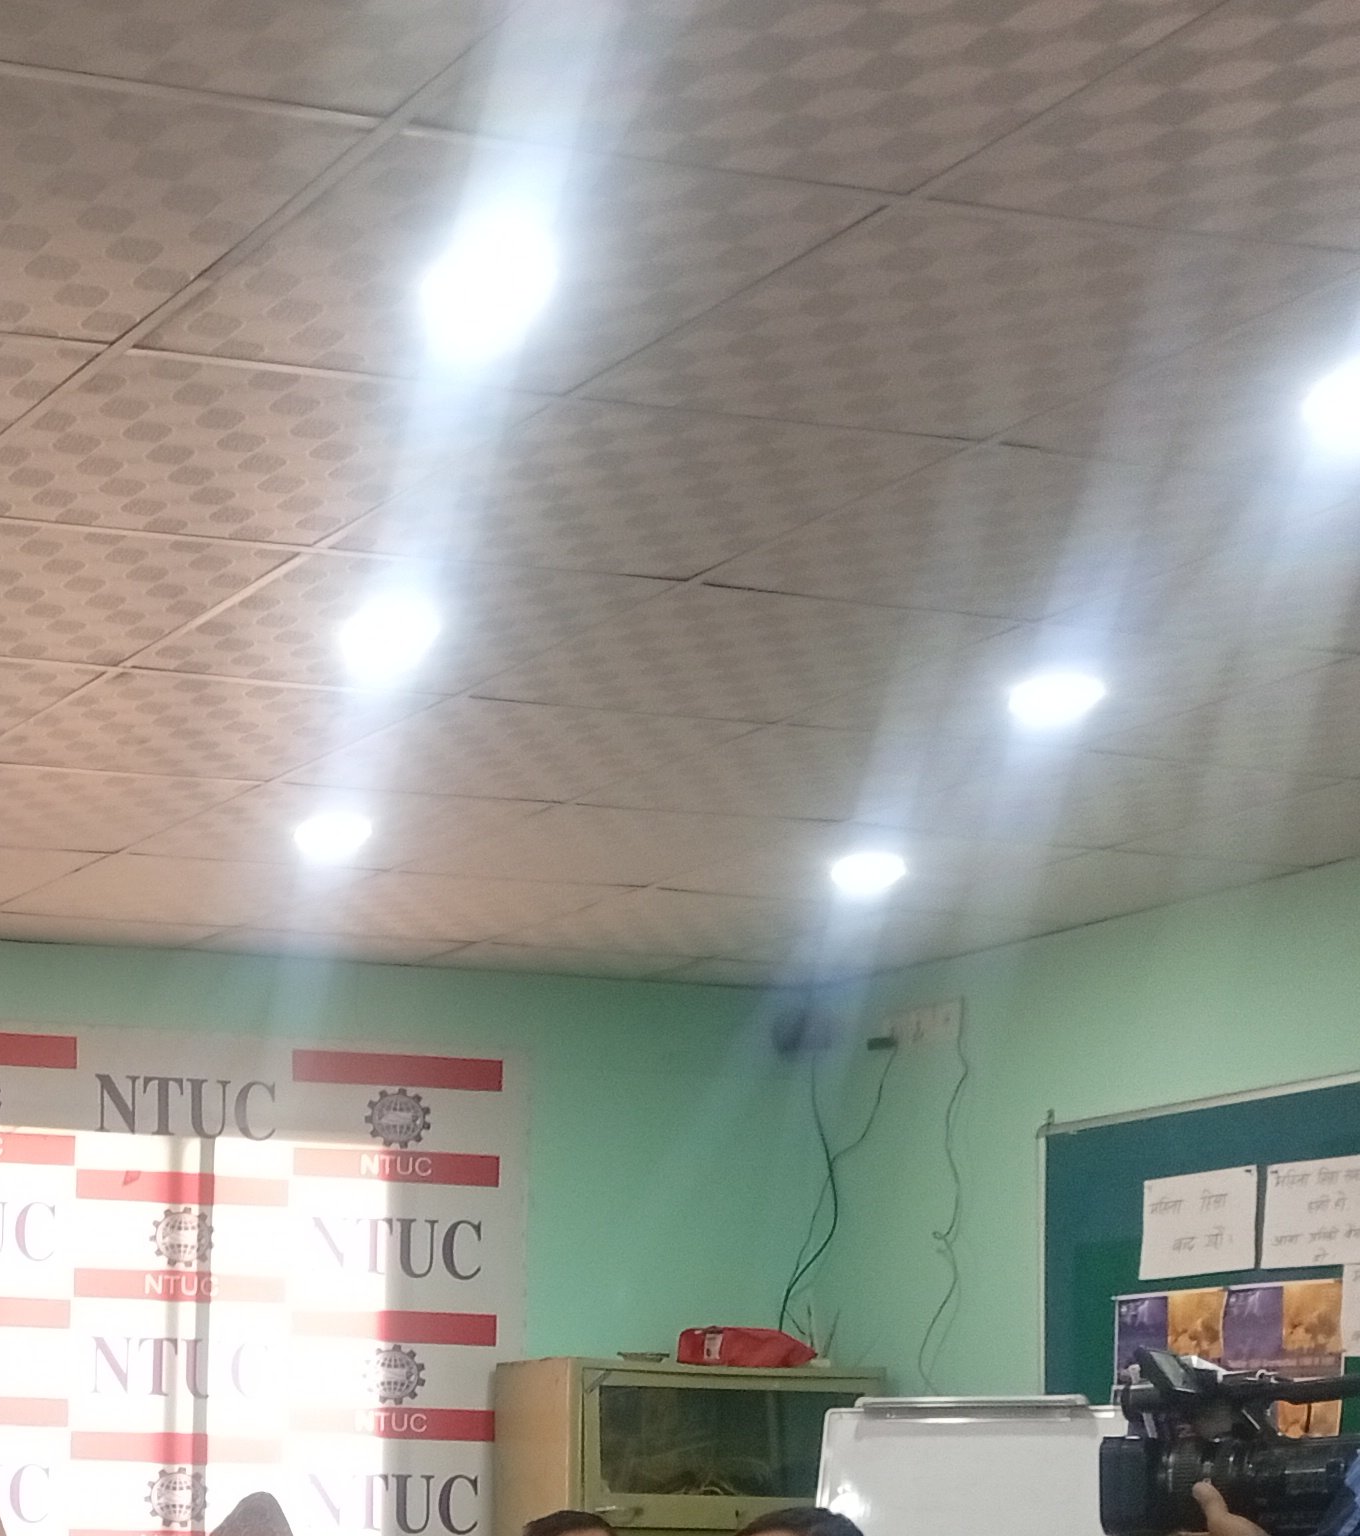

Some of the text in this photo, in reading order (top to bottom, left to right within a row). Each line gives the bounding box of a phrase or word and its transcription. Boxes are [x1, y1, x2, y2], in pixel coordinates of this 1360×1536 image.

[95, 1073, 277, 1141] NTUC
[360, 1153, 432, 1176] NTUC
[312, 1216, 482, 1281] NTUC
[143, 1273, 219, 1297] NTUC
[92, 1336, 269, 1399] NTUC
[354, 1412, 428, 1433] NTUC
[307, 1472, 480, 1536] NTUC
